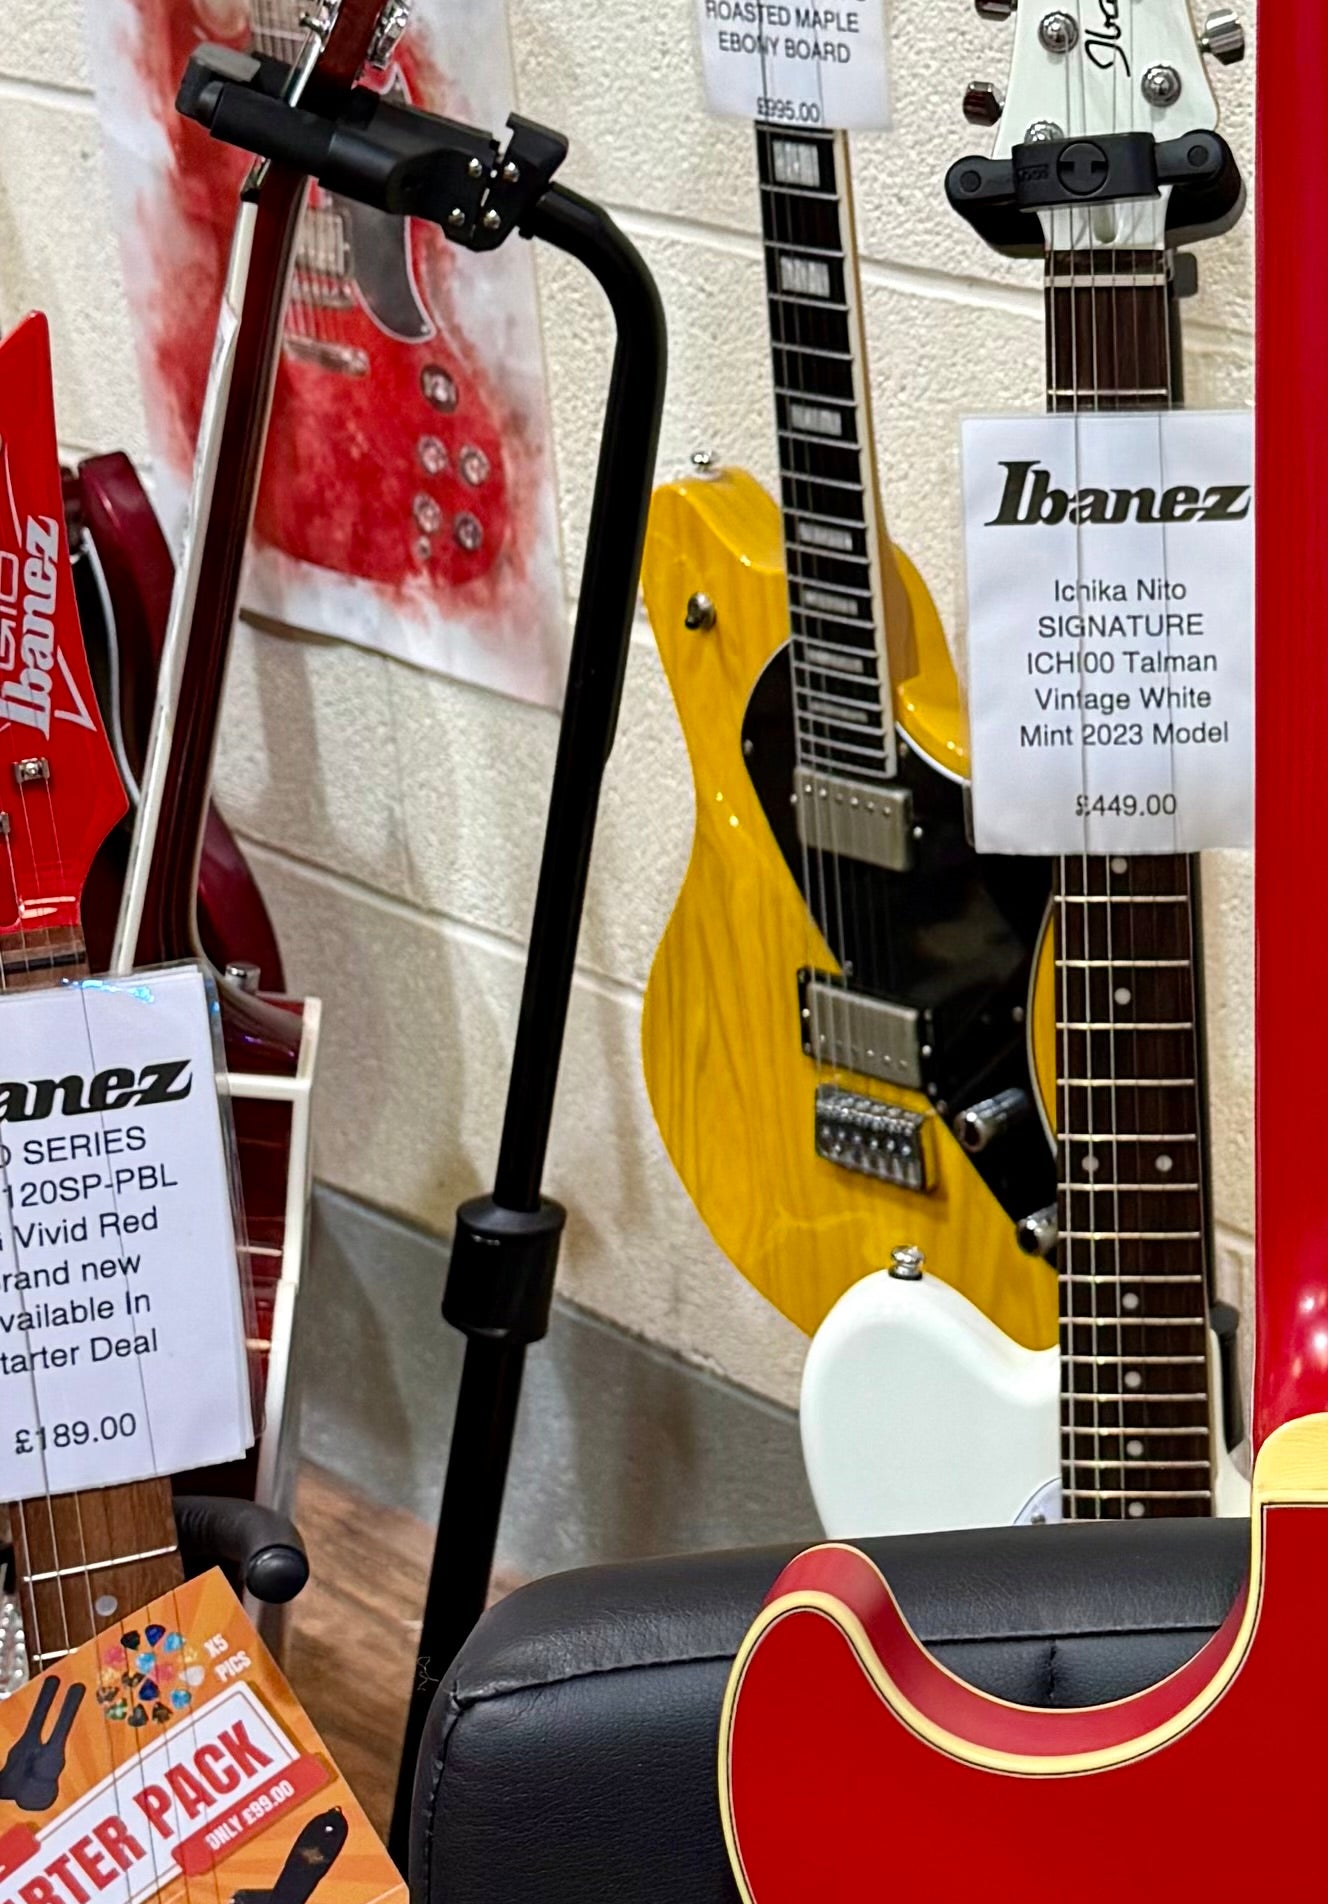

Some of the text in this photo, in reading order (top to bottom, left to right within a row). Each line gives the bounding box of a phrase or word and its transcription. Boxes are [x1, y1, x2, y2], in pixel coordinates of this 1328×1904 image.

[706, 0, 859, 33] ROASTED MAPLE
[719, 31, 851, 64] EBONY BOARD
[984, 460, 1251, 527] Ibanez
[1055, 578, 1187, 602] Ichika Nito
[0, 515, 59, 741] Ibanez
[1038, 613, 1204, 639] SIGNATURE
[1123, 650, 1217, 673] Talman
[1034, 686, 1212, 715] Vintage White
[1020, 721, 1229, 748] Mint 2023 Model
[0, 1058, 193, 1123] anez
[23, 1125, 147, 1165] SERIES
[14, 1216, 88, 1248] Vivid
[100, 1206, 159, 1238] Red
[2, 1255, 142, 1292] rand new
[0, 1291, 151, 1333] vailable In
[0, 1329, 159, 1375] tarter Deal
[15, 1412, 136, 1455] £189.00
[204, 1633, 229, 1658] X5
[214, 1650, 252, 1683] PICS
[133, 1719, 274, 1840] PACK
[205, 1779, 296, 1851] ONLY £99.00
